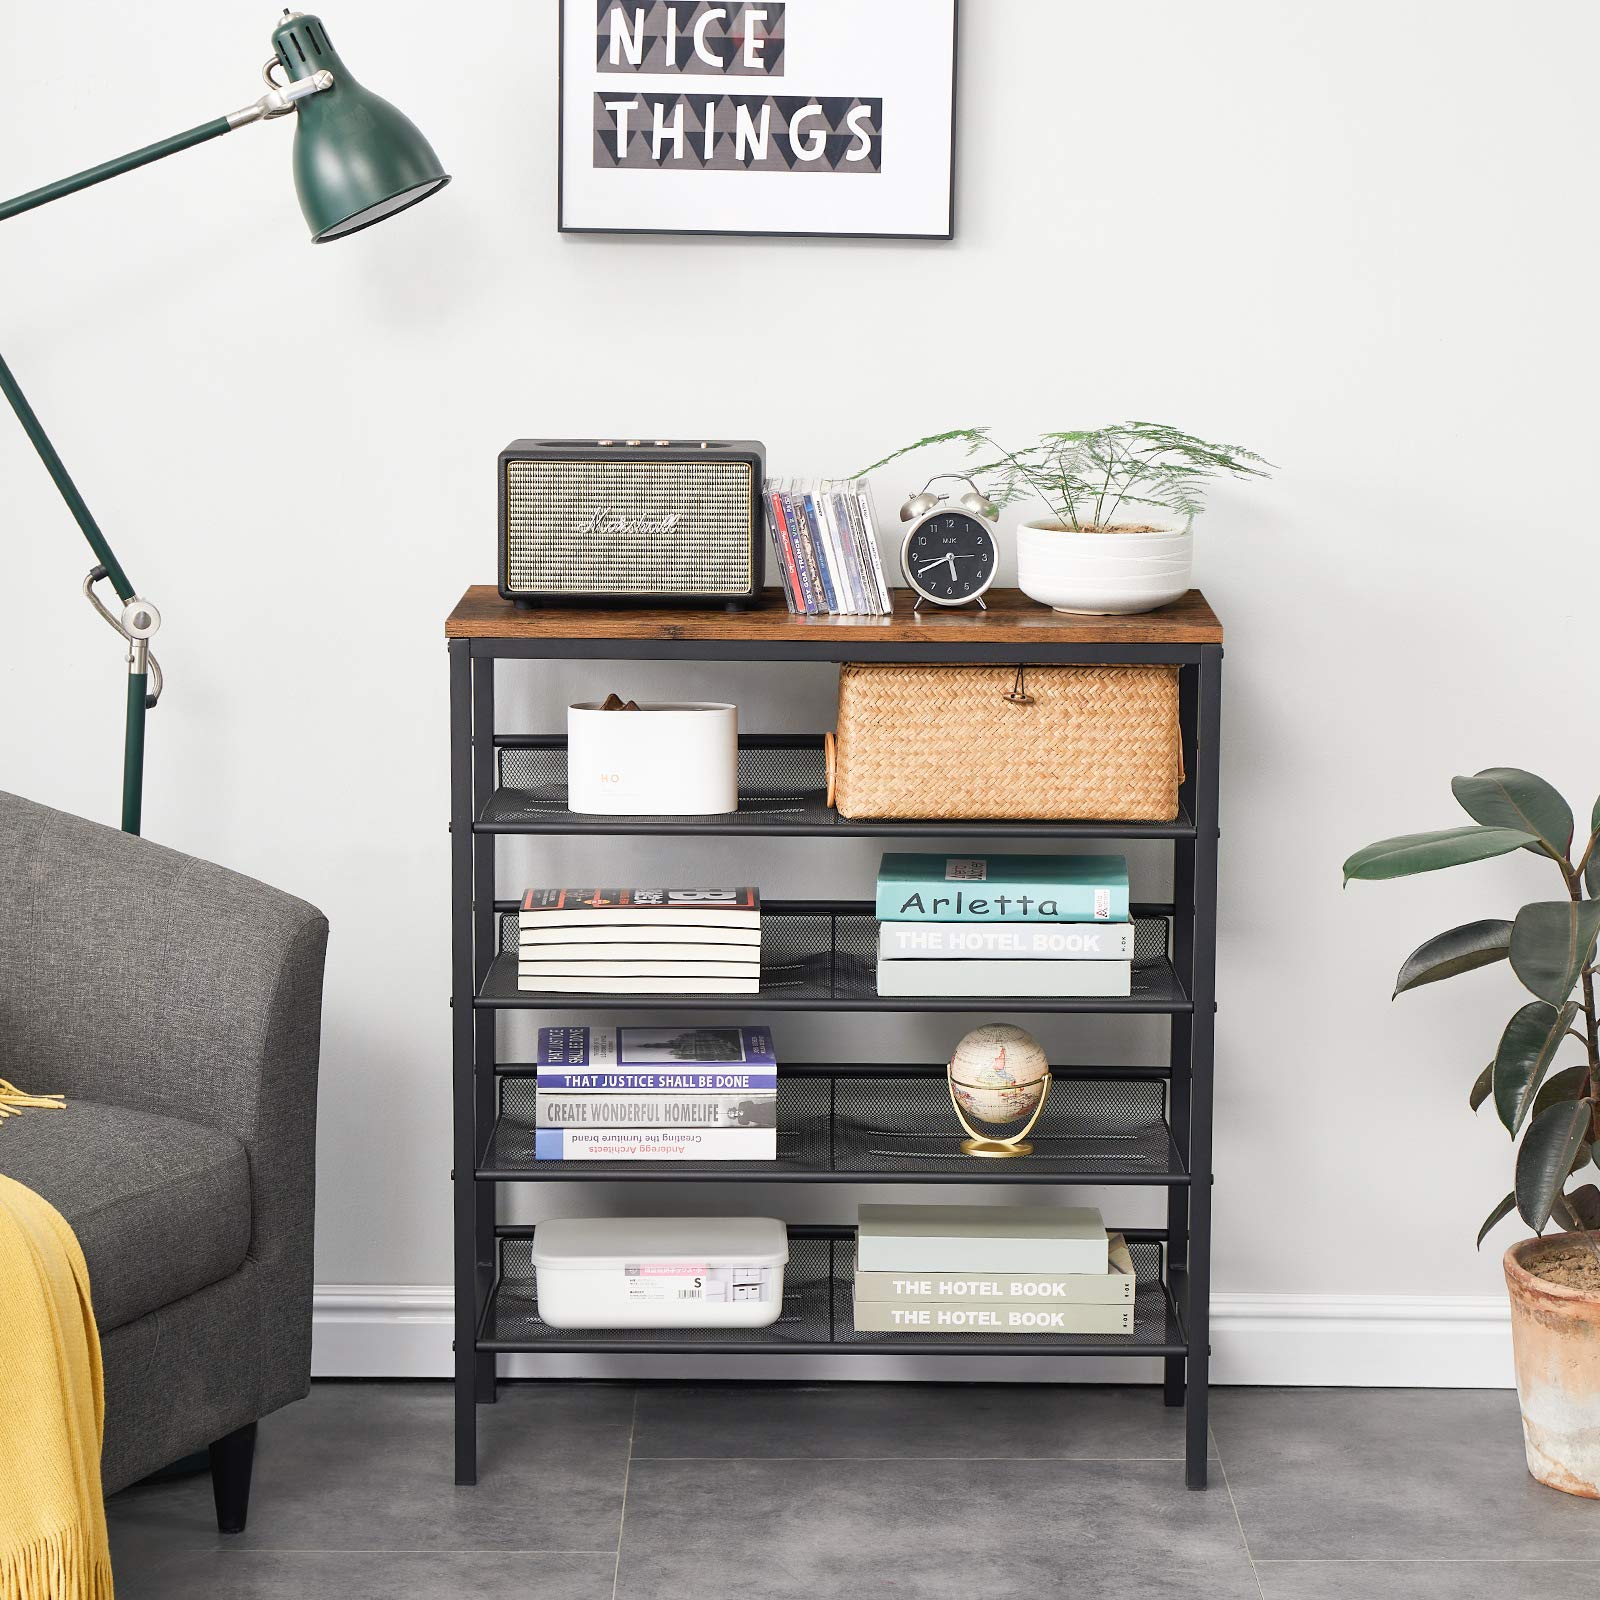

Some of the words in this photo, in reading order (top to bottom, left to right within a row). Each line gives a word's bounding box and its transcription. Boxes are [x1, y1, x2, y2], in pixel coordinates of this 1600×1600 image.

[609, 7, 768, 69] NICE
[605, 101, 872, 162] THINGS
[577, 506, 683, 535] Marshall
[945, 519, 955, 528] 12
[929, 524, 938, 533] 11
[917, 537, 927, 546] 10
[976, 536, 983, 545] 2
[911, 552, 919, 562] 9
[981, 553, 988, 562] 3
[976, 570, 982, 578] 4
[930, 581, 937, 590] 7
[946, 586, 953, 595] 6
[964, 582, 970, 590] 5
[899, 891, 1059, 916] Arletta
[896, 931, 942, 950] THE
[950, 932, 1026, 951] HOTEL
[1032, 934, 1101, 952] BOOK
[548, 1029, 564, 1049] JUSTICE
[568, 1028, 584, 1042] DONE
[548, 1049, 564, 1063] THAT
[568, 1049, 584, 1064] SHALL
[564, 1075, 599, 1087] THAT
[602, 1075, 654, 1088] JUSTICE
[658, 1075, 696, 1088] SHALL
[698, 1075, 713, 1088] BE
[716, 1075, 750, 1088] DONE
[547, 1102, 587, 1122] CREATE
[591, 1102, 660, 1122] WONDERFUL
[664, 1102, 719, 1122] HOMELIFE
[571, 1135, 599, 1143] brand
[601, 1135, 642, 1143] furniture
[645, 1135, 660, 1143] the
[662, 1133, 702, 1143] Creating
[588, 1145, 637, 1154] Architects
[639, 1144, 685, 1154] Anderegg
[694, 1277, 702, 1288] S
[892, 1280, 932, 1295] THE
[939, 1281, 1003, 1296] HOTEL
[1010, 1282, 1067, 1297] BOOK
[891, 1310, 931, 1325] THE
[937, 1311, 1002, 1326] HOTEL
[1008, 1312, 1065, 1327] BOOK
